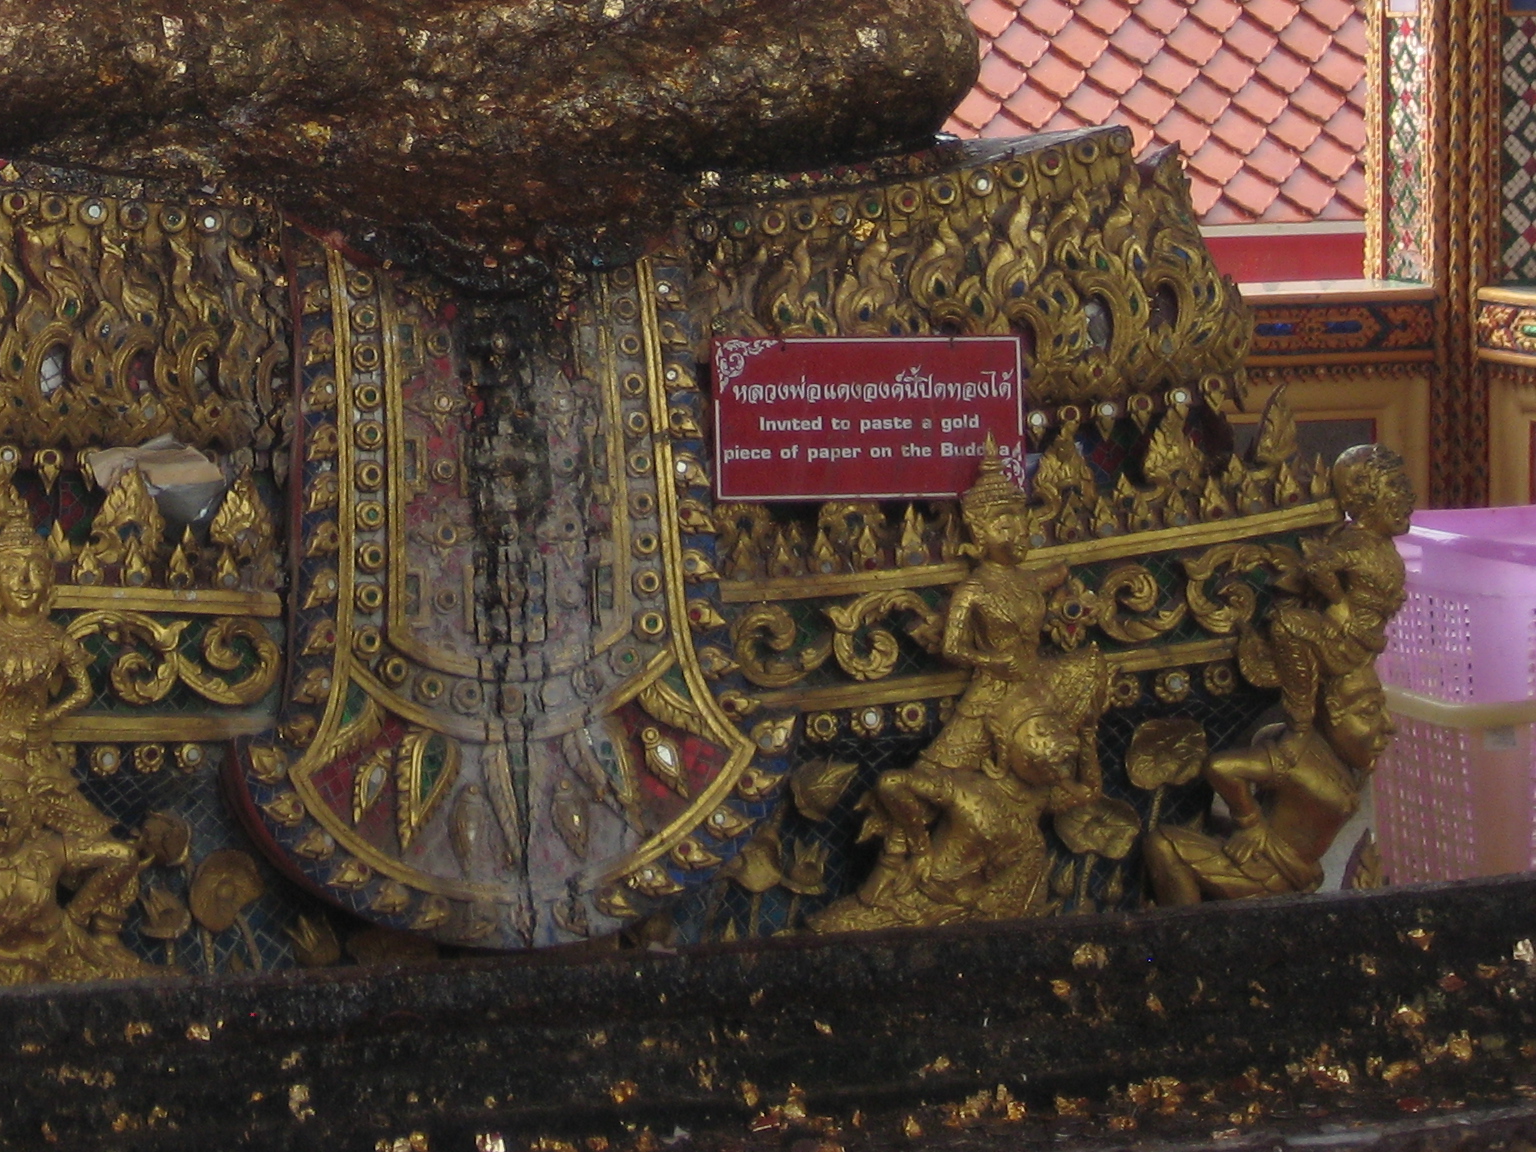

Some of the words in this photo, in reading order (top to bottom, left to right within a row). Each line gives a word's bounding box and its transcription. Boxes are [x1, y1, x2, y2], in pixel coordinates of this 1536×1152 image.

[759, 416, 822, 432] Invited
[832, 418, 850, 431] to
[860, 417, 913, 433] paste
[922, 419, 932, 430] a
[941, 415, 979, 432] gold
[724, 446, 771, 463] piece
[780, 446, 799, 460] of
[807, 446, 861, 462] paper
[870, 447, 892, 458] on
[901, 445, 931, 458] the
[941, 443, 1010, 457] Budda
